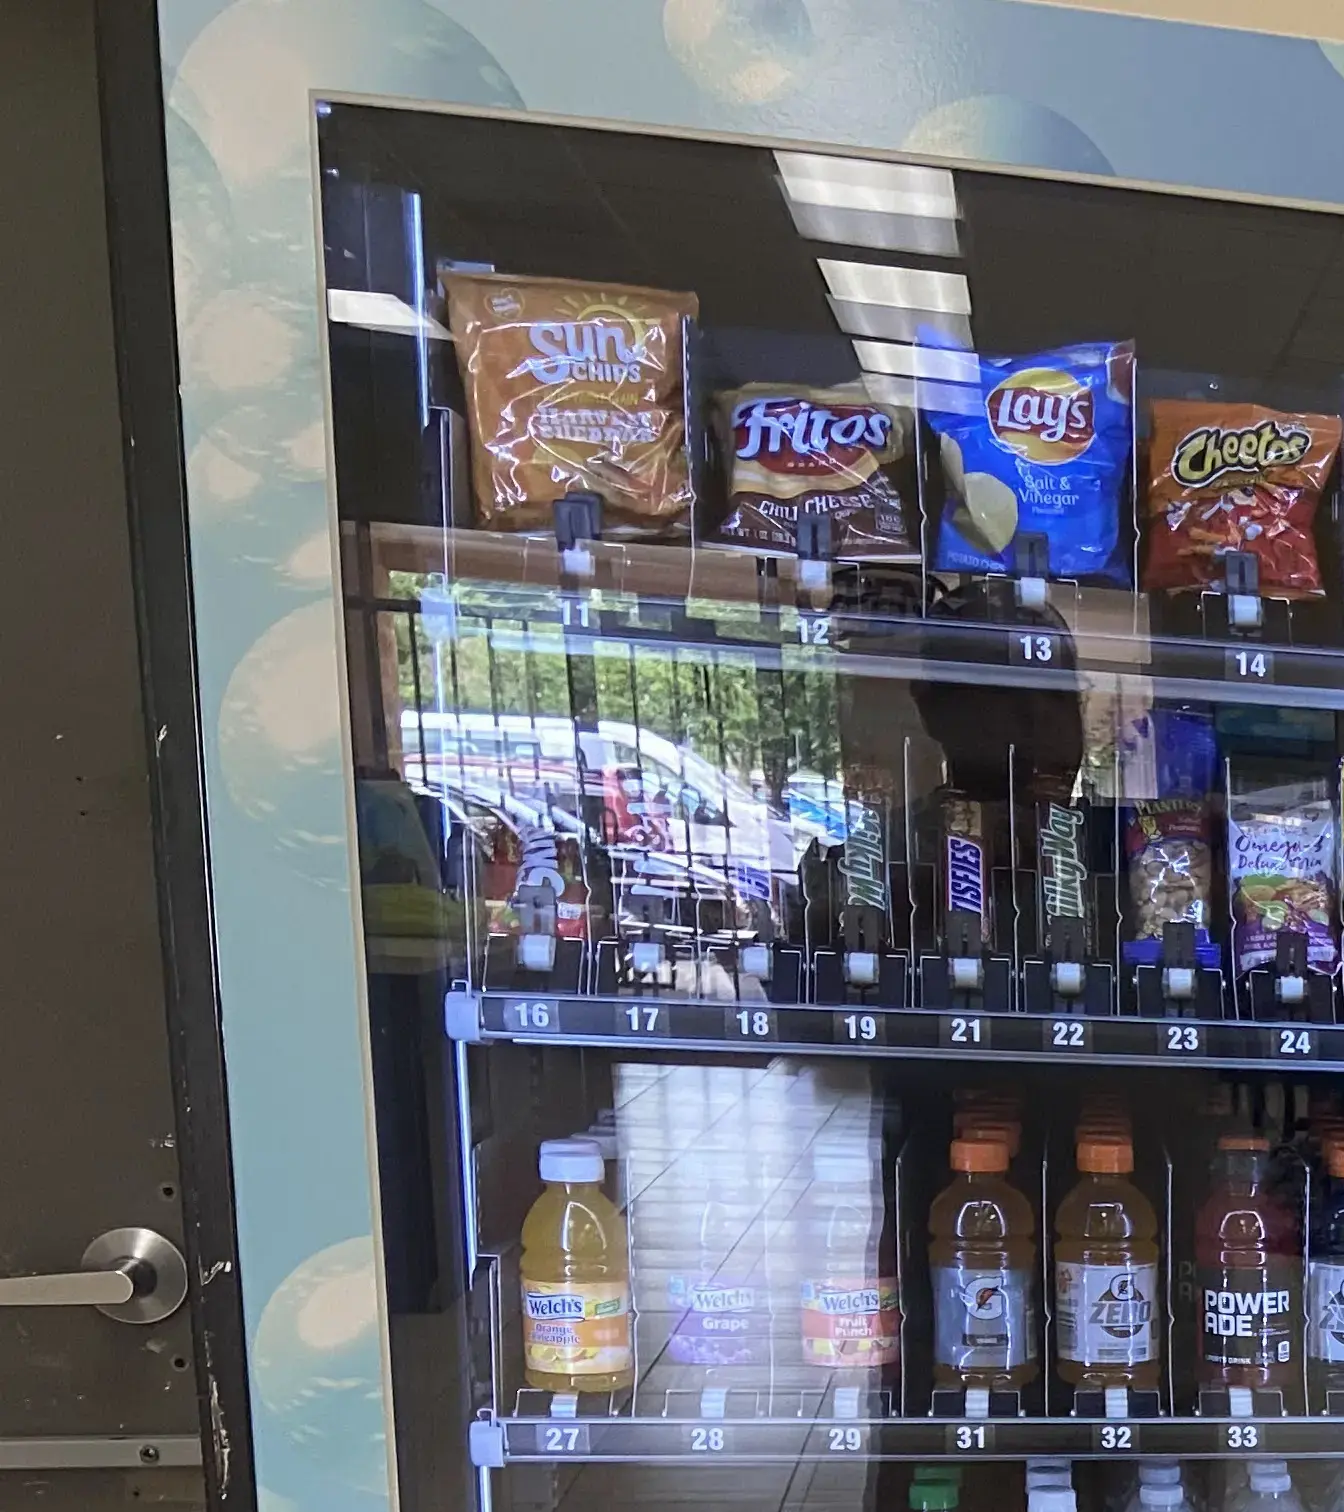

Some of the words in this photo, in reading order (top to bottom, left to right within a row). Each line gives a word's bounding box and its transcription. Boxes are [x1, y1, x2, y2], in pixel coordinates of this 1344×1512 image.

[571, 362, 641, 383] CHIPS
[997, 389, 1090, 442] Lay's
[1176, 423, 1308, 482] Cheetos
[1025, 475, 1055, 490] Salt
[1019, 488, 1079, 509] Vinegar
[1019, 635, 1053, 661] 13
[1235, 652, 1266, 678] 14
[514, 1002, 549, 1028] 16
[626, 1006, 659, 1031] 17
[736, 1010, 769, 1036] 18
[844, 1015, 877, 1040] 19
[951, 1018, 981, 1042] 21
[1052, 1022, 1084, 1047] 22
[1168, 1026, 1199, 1050] 23
[1280, 1031, 1311, 1054] 24
[528, 1299, 582, 1315] Welch's
[822, 1288, 879, 1310] Welch's
[1205, 1291, 1290, 1314] POWER
[702, 1316, 749, 1333] Grape
[545, 1427, 580, 1452] 27
[691, 1427, 725, 1451] 28
[829, 1427, 862, 1451] 29
[956, 1426, 985, 1449] 31
[1101, 1427, 1132, 1449] 32
[1228, 1425, 1258, 1448] 33
